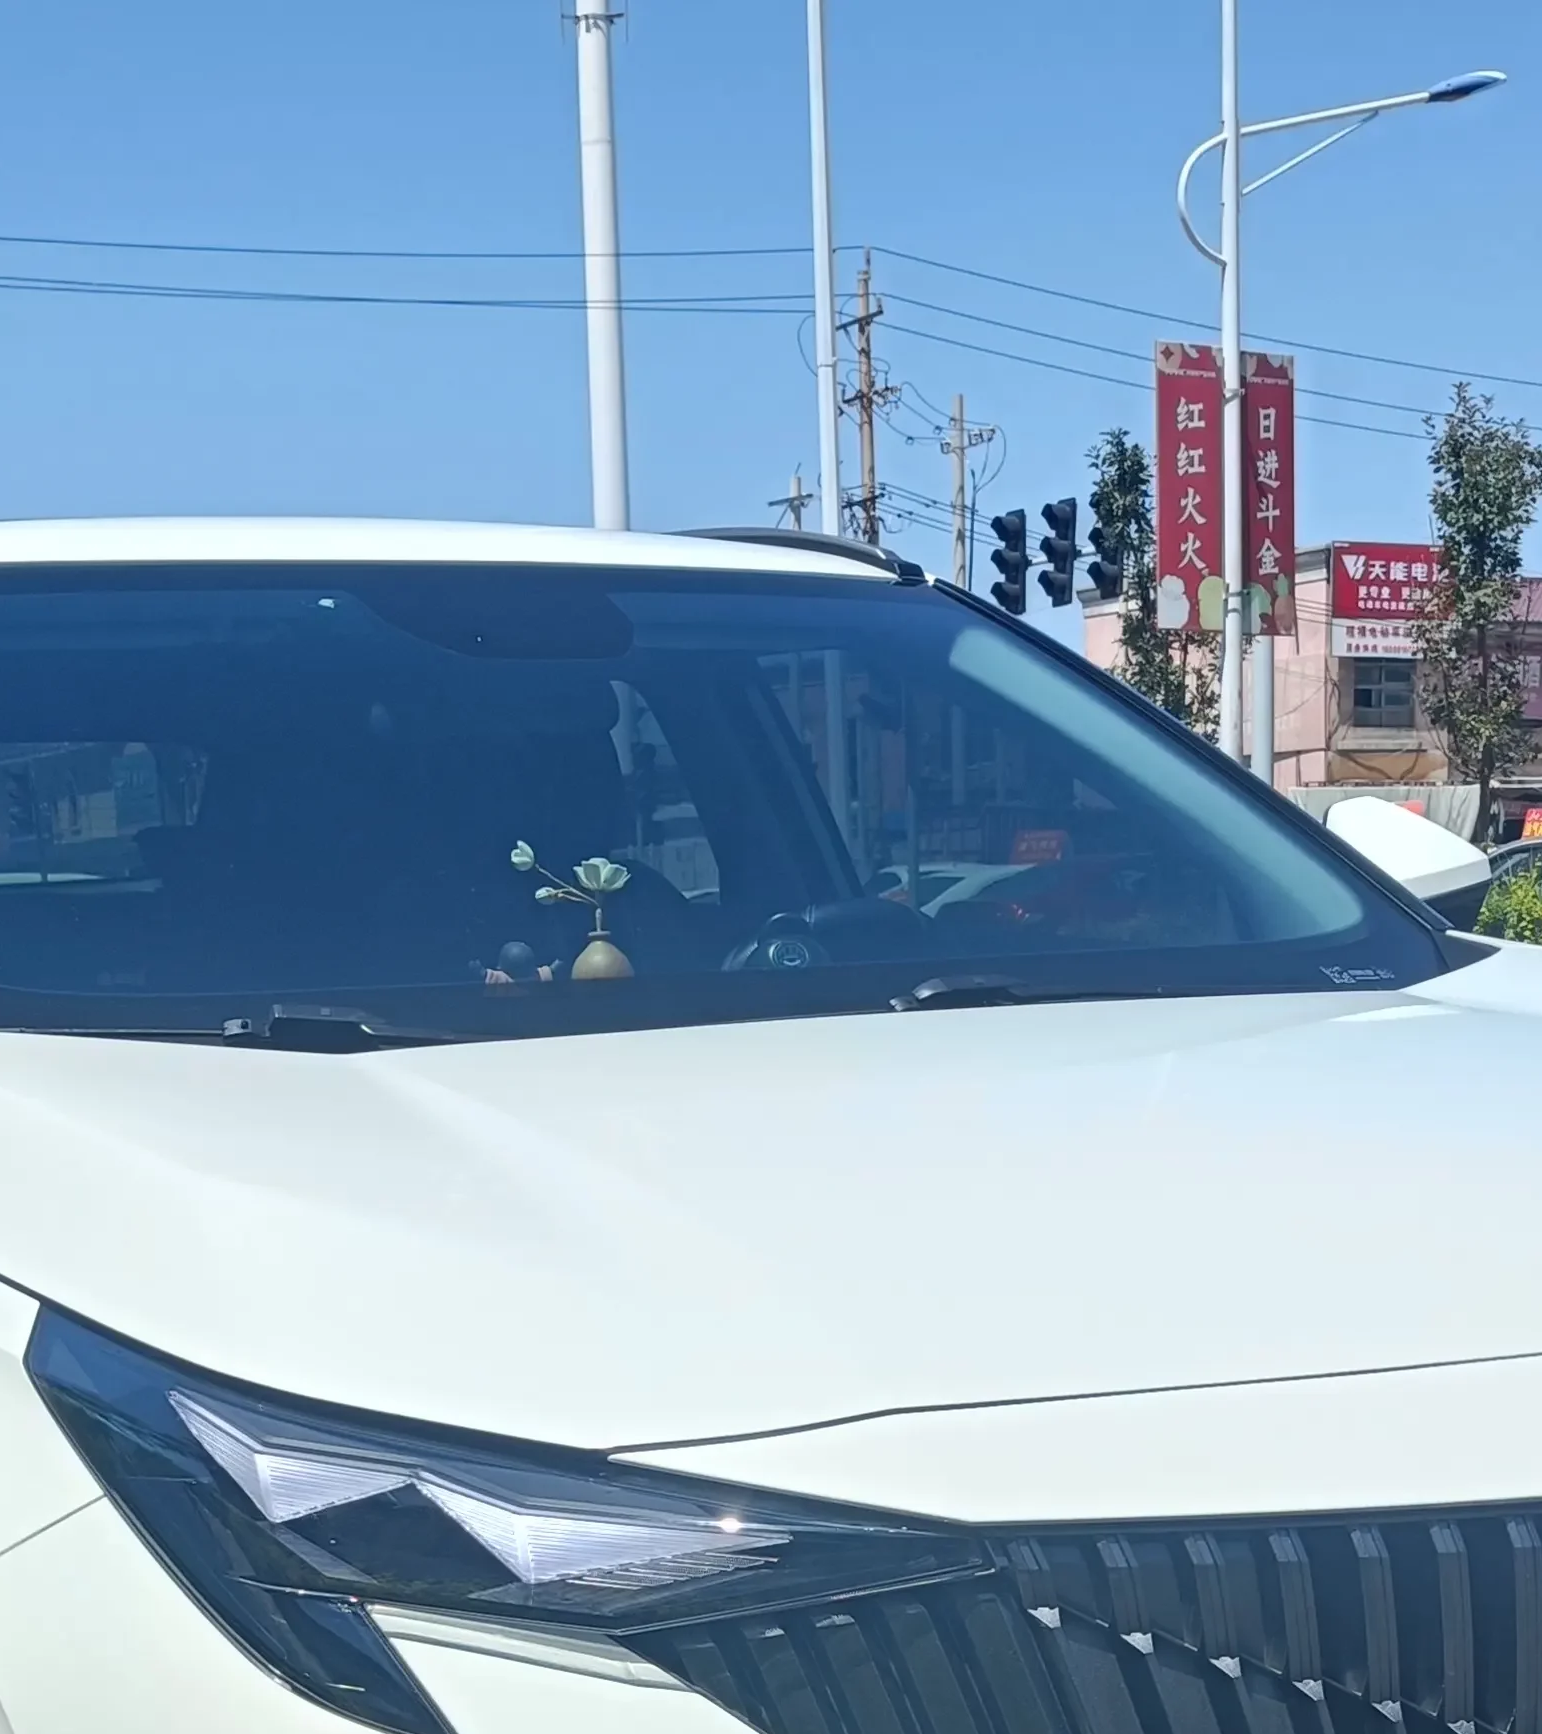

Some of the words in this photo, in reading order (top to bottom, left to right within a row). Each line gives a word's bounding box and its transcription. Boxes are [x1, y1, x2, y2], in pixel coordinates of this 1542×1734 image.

[1176, 397, 1207, 572] 红红火火
[1256, 406, 1282, 575] 日进斗金
